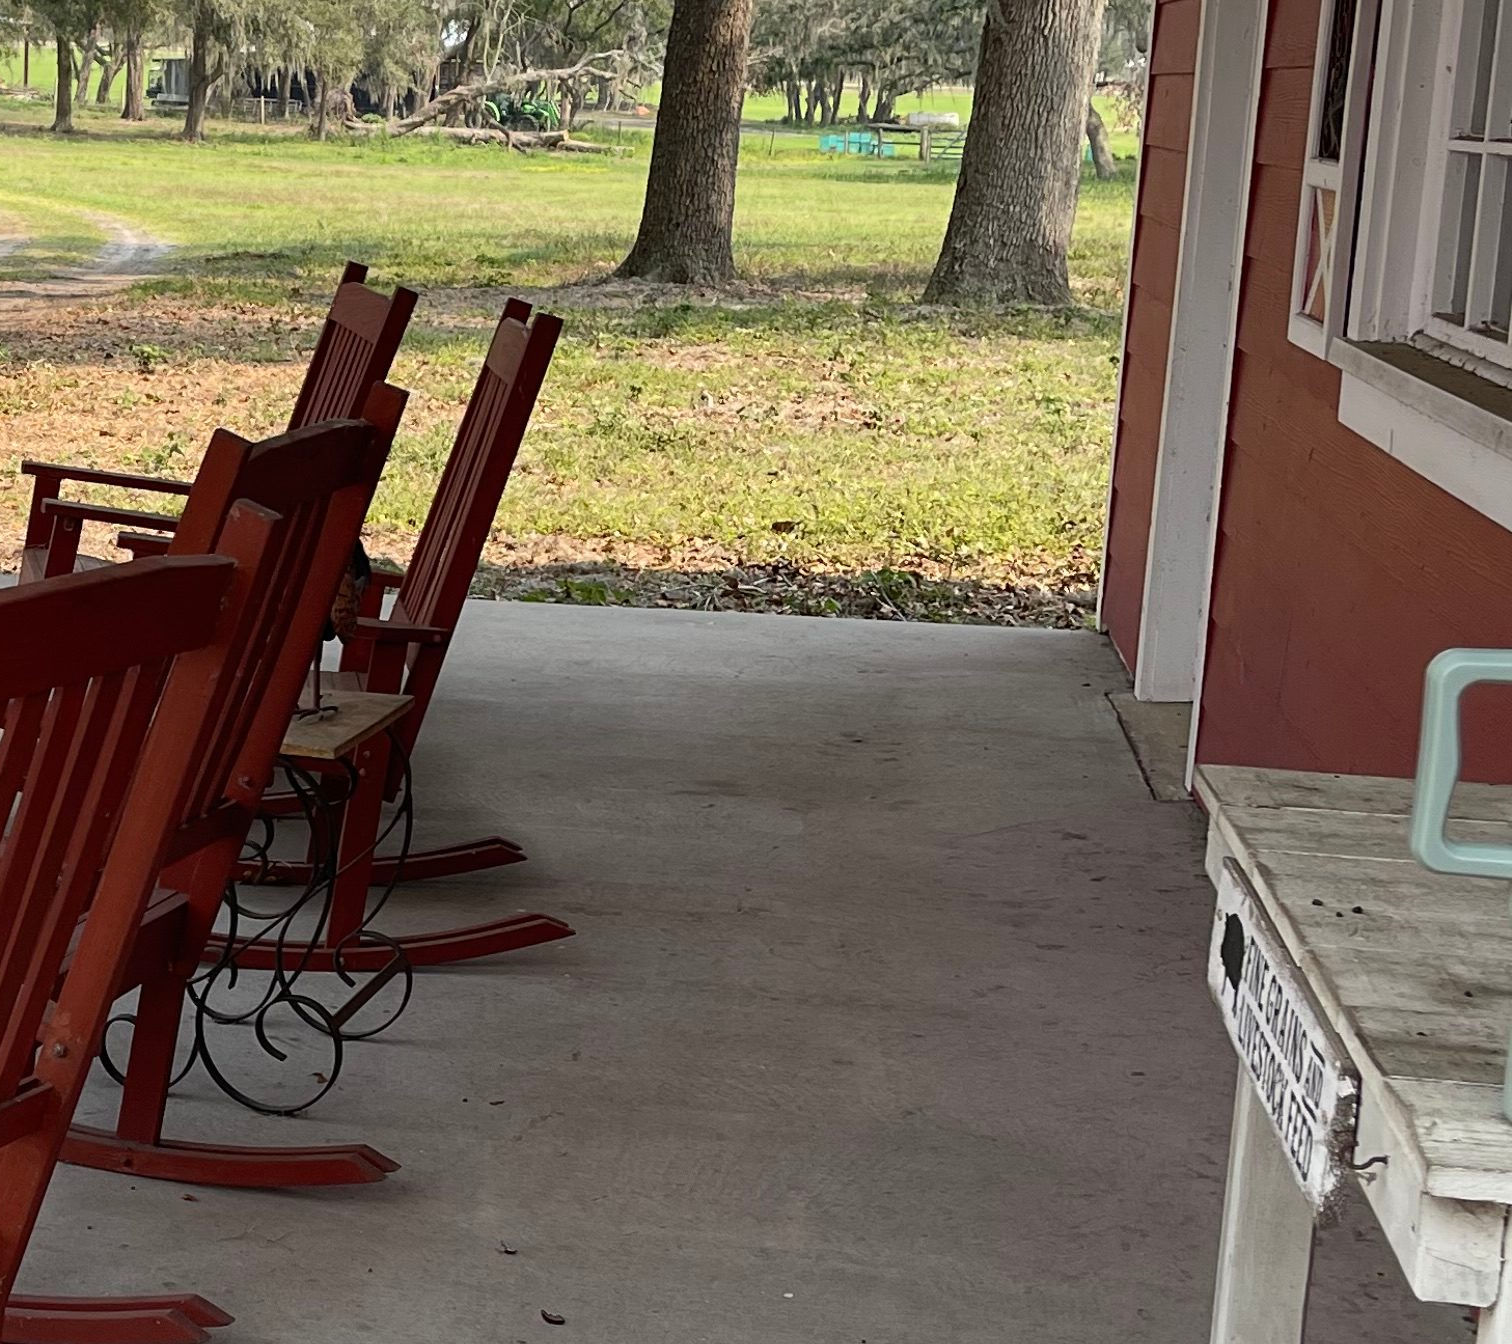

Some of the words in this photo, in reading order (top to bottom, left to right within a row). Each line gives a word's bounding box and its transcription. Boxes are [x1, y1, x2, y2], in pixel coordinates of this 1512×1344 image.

[1238, 1001, 1289, 1132] LIVESTOCK
[1285, 1090, 1313, 1182] FEED
[1242, 936, 1270, 1012] FINE
[1265, 974, 1307, 1083] GRAINS
[1304, 1054, 1323, 1109] AND
